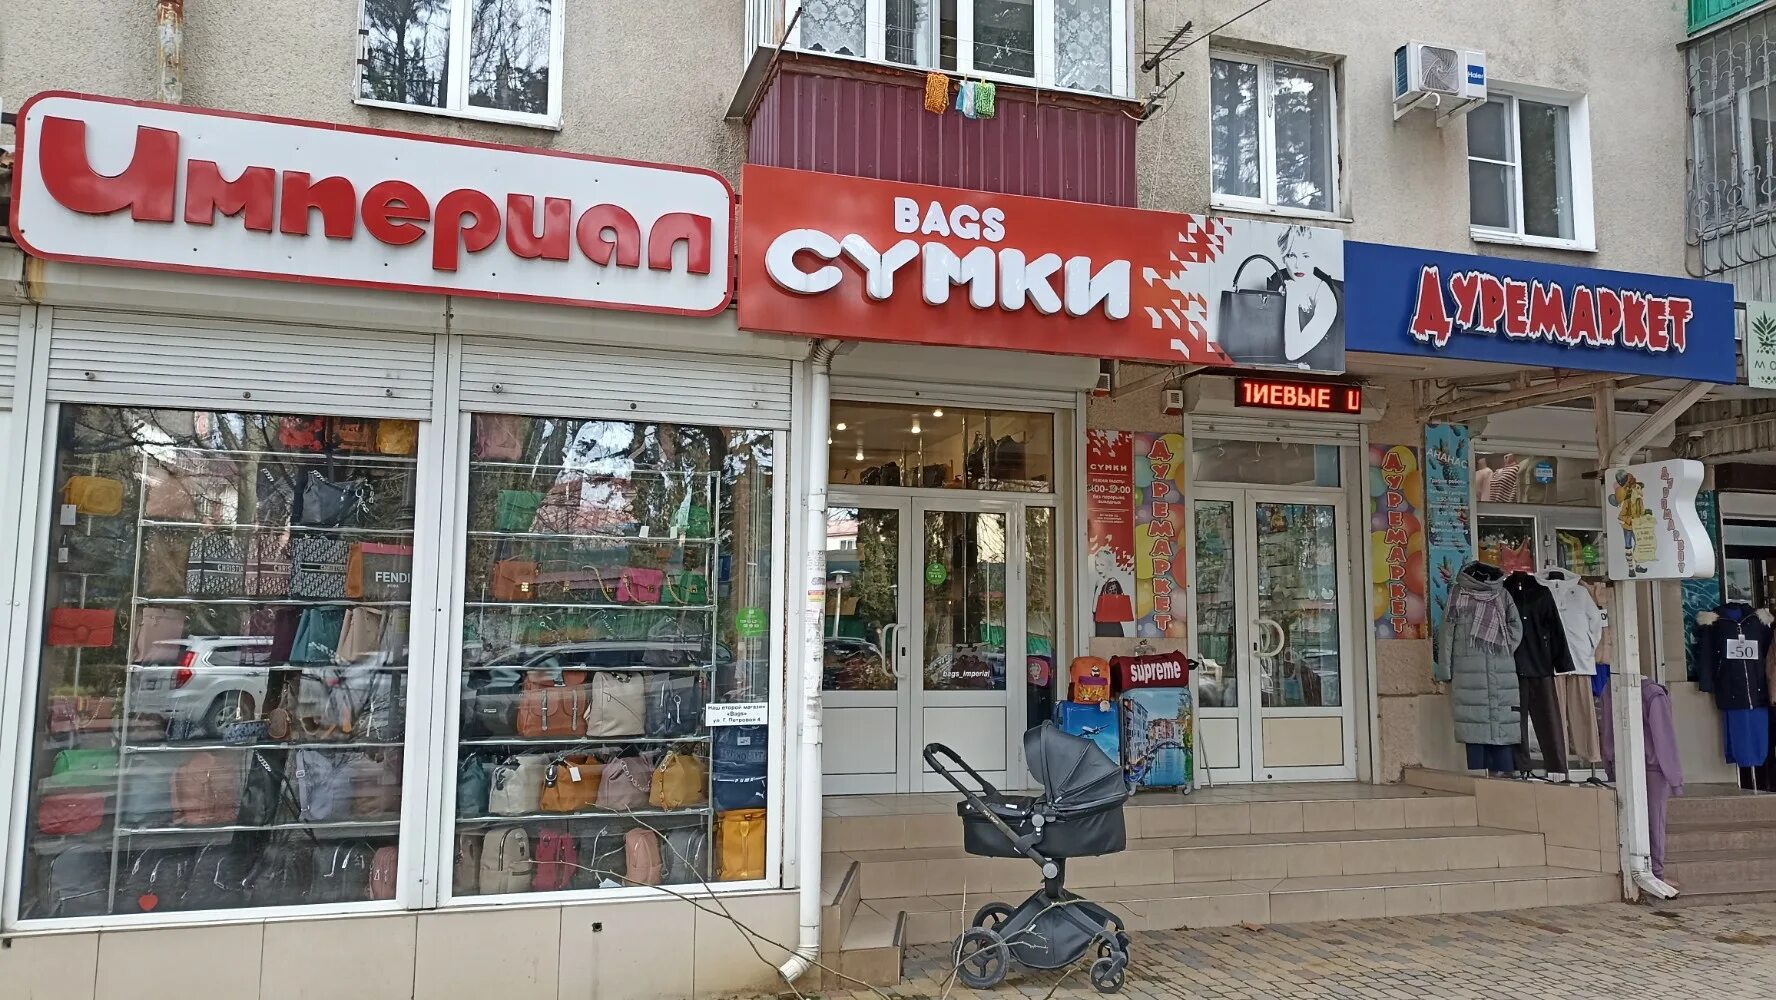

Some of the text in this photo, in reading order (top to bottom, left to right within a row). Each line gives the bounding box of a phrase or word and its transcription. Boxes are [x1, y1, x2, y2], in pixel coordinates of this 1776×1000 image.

[1467, 71, 1484, 79] Haier
[38, 115, 712, 275] Империал
[894, 197, 1006, 242] BAGS
[765, 228, 1131, 320] СУМКИ
[1410, 265, 1693, 353] ДУРЕМАРКЕТ
[1090, 463, 1128, 472] СУМКИ
[1427, 448, 1468, 469] АНАНАС
[1148, 439, 1174, 631] ДУРЕМАРКЕТ
[1382, 452, 1407, 633] ДУРЕМАРКЕТ
[375, 571, 411, 583] FENDI
[1730, 646, 1753, 658] -50
[1130, 660, 1181, 684] supreme
